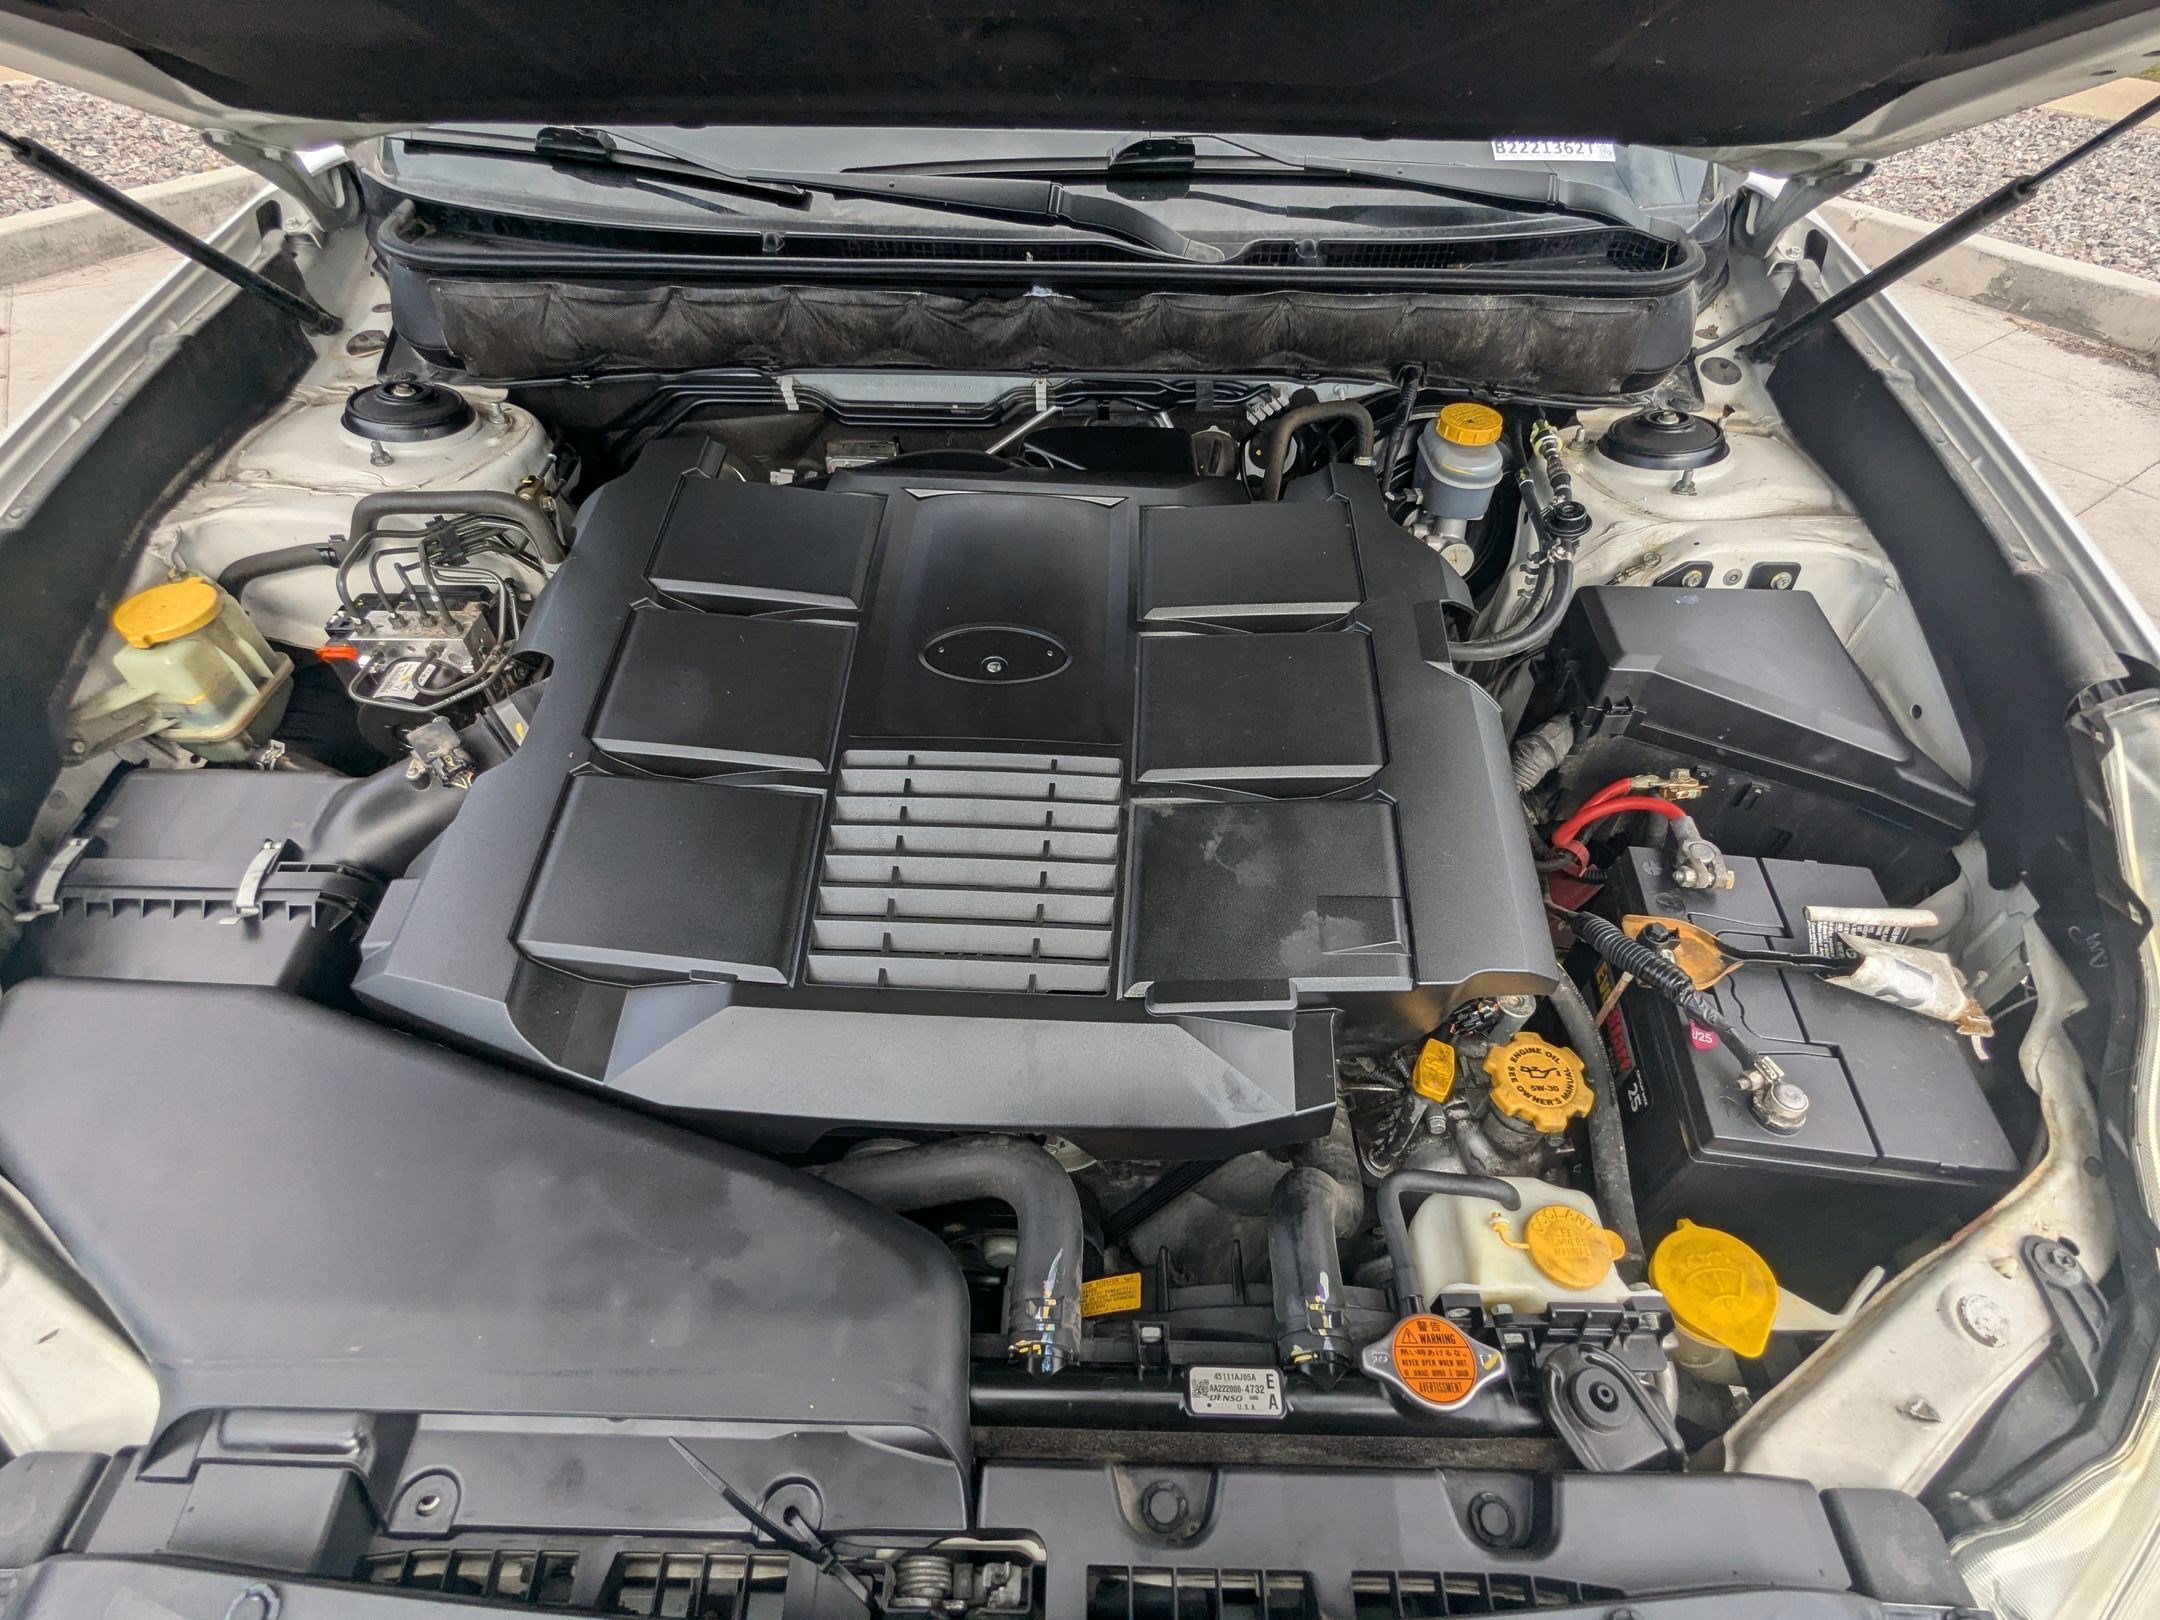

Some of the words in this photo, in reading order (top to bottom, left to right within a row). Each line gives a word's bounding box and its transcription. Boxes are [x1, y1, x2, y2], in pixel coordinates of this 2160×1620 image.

[1510, 1047, 1542, 1063] ENGINE
[1545, 1051, 1560, 1064] OIL
[1507, 1066, 1519, 1083] SEE
[1517, 1085, 1562, 1106] OWNER'S
[1561, 1067, 1575, 1101] MANUAL
[1628, 1082, 1642, 1113] 25
[1531, 1208, 1594, 1232] COOLANT
[1418, 1333, 1456, 1345] WARNING
[1266, 1373, 1275, 1389] E
[1209, 1394, 1243, 1402] DENSO
[1269, 1393, 1279, 1410] A
